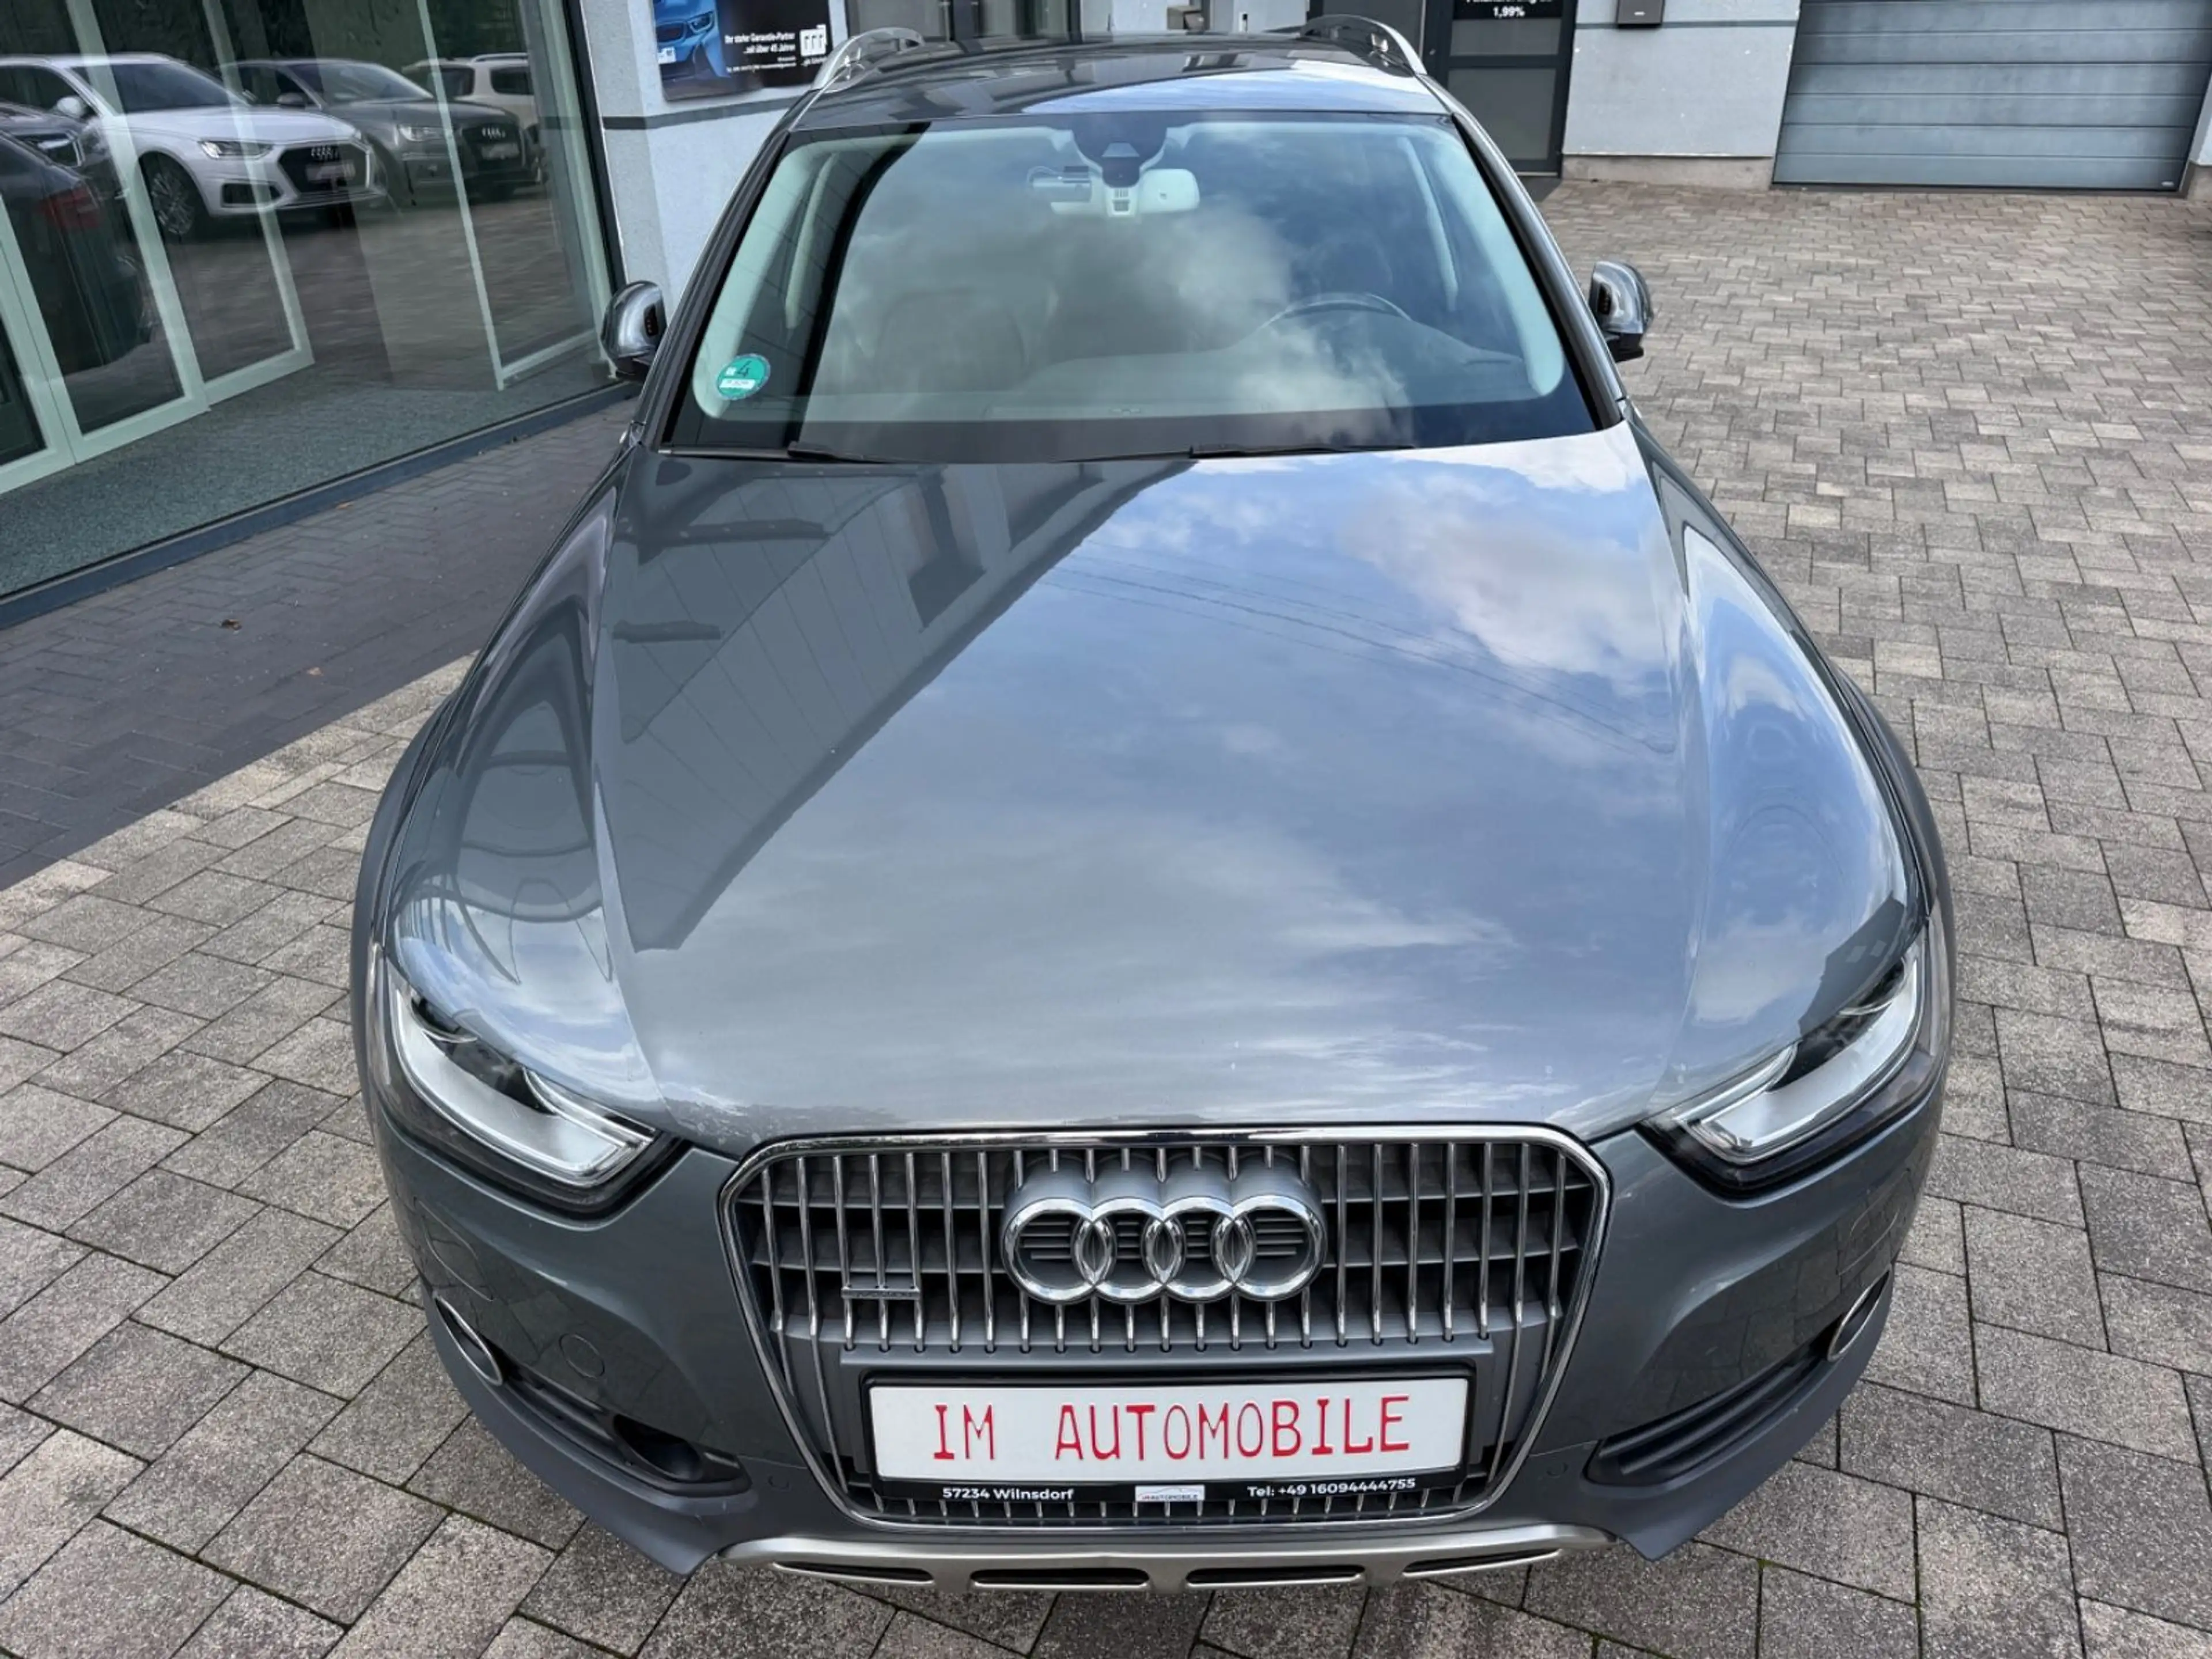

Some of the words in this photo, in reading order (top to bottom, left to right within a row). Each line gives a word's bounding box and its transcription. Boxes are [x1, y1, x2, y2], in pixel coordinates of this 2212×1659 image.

[1493, 6, 1525, 18] 1,99%
[737, 360, 752, 377] 4
[933, 1404, 995, 1461] IM
[1055, 1396, 1410, 1461] AUTOMOBILE
[942, 1487, 990, 1499] 57234
[993, 1488, 1074, 1501] Wilnsdorf
[1247, 1486, 1275, 1497] Tel:
[1278, 1484, 1307, 1496] +49
[1310, 1478, 1416, 1494] 16094444755
